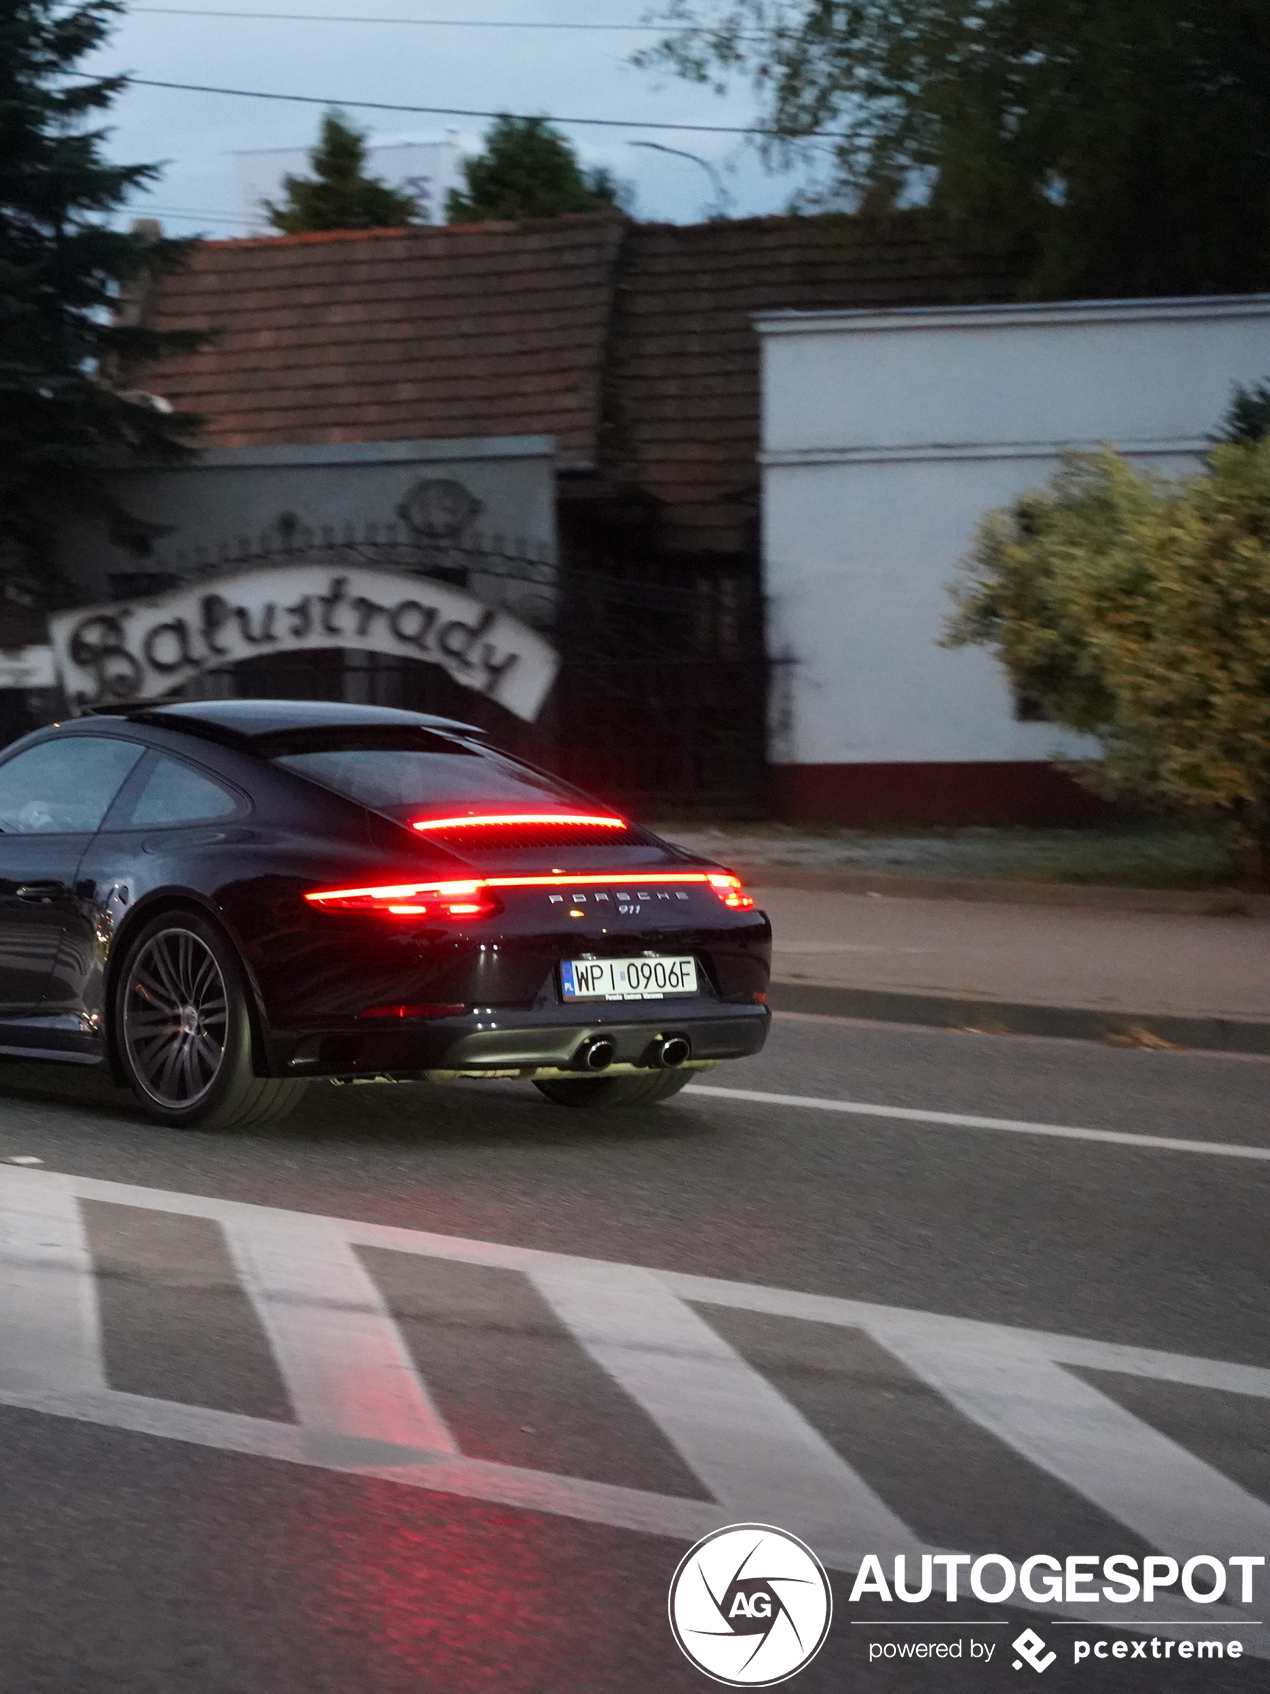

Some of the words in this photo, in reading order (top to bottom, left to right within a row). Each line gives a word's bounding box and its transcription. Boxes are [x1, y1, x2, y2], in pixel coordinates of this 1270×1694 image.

[67, 576, 521, 702] Balustrady
[549, 892, 689, 903] PORSCHE
[619, 905, 640, 914] 911
[627, 961, 691, 989] 0906F
[564, 982, 574, 991] PL
